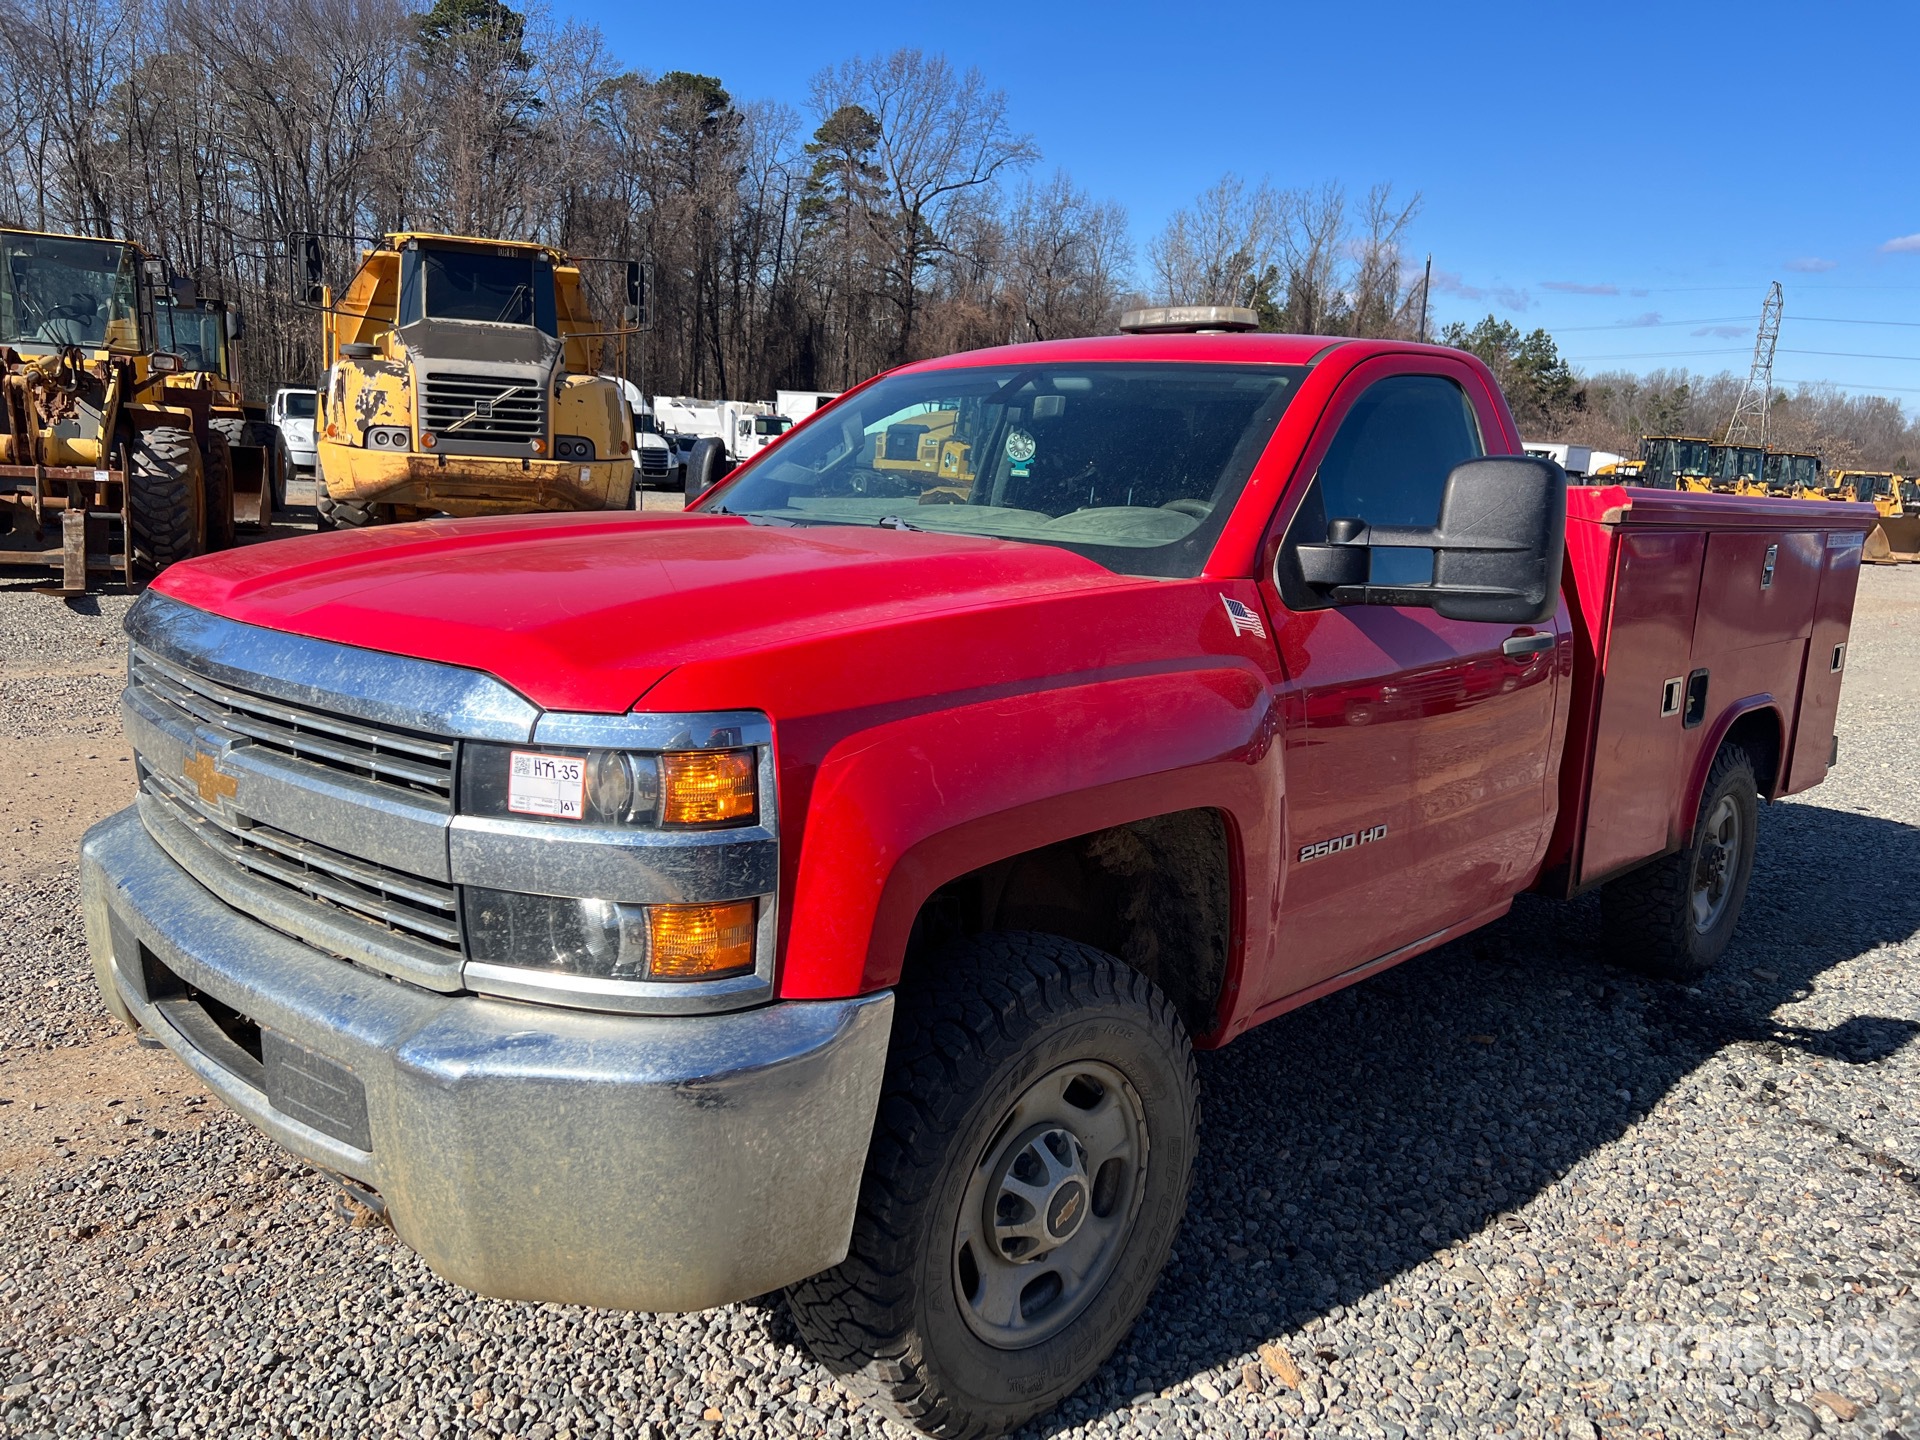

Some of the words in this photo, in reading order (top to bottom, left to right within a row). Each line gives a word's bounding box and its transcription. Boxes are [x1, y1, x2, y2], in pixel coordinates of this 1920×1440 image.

[1009, 446, 1032, 458] BOMB
[1299, 833, 1356, 863] 2500
[1358, 824, 1387, 845] HD
